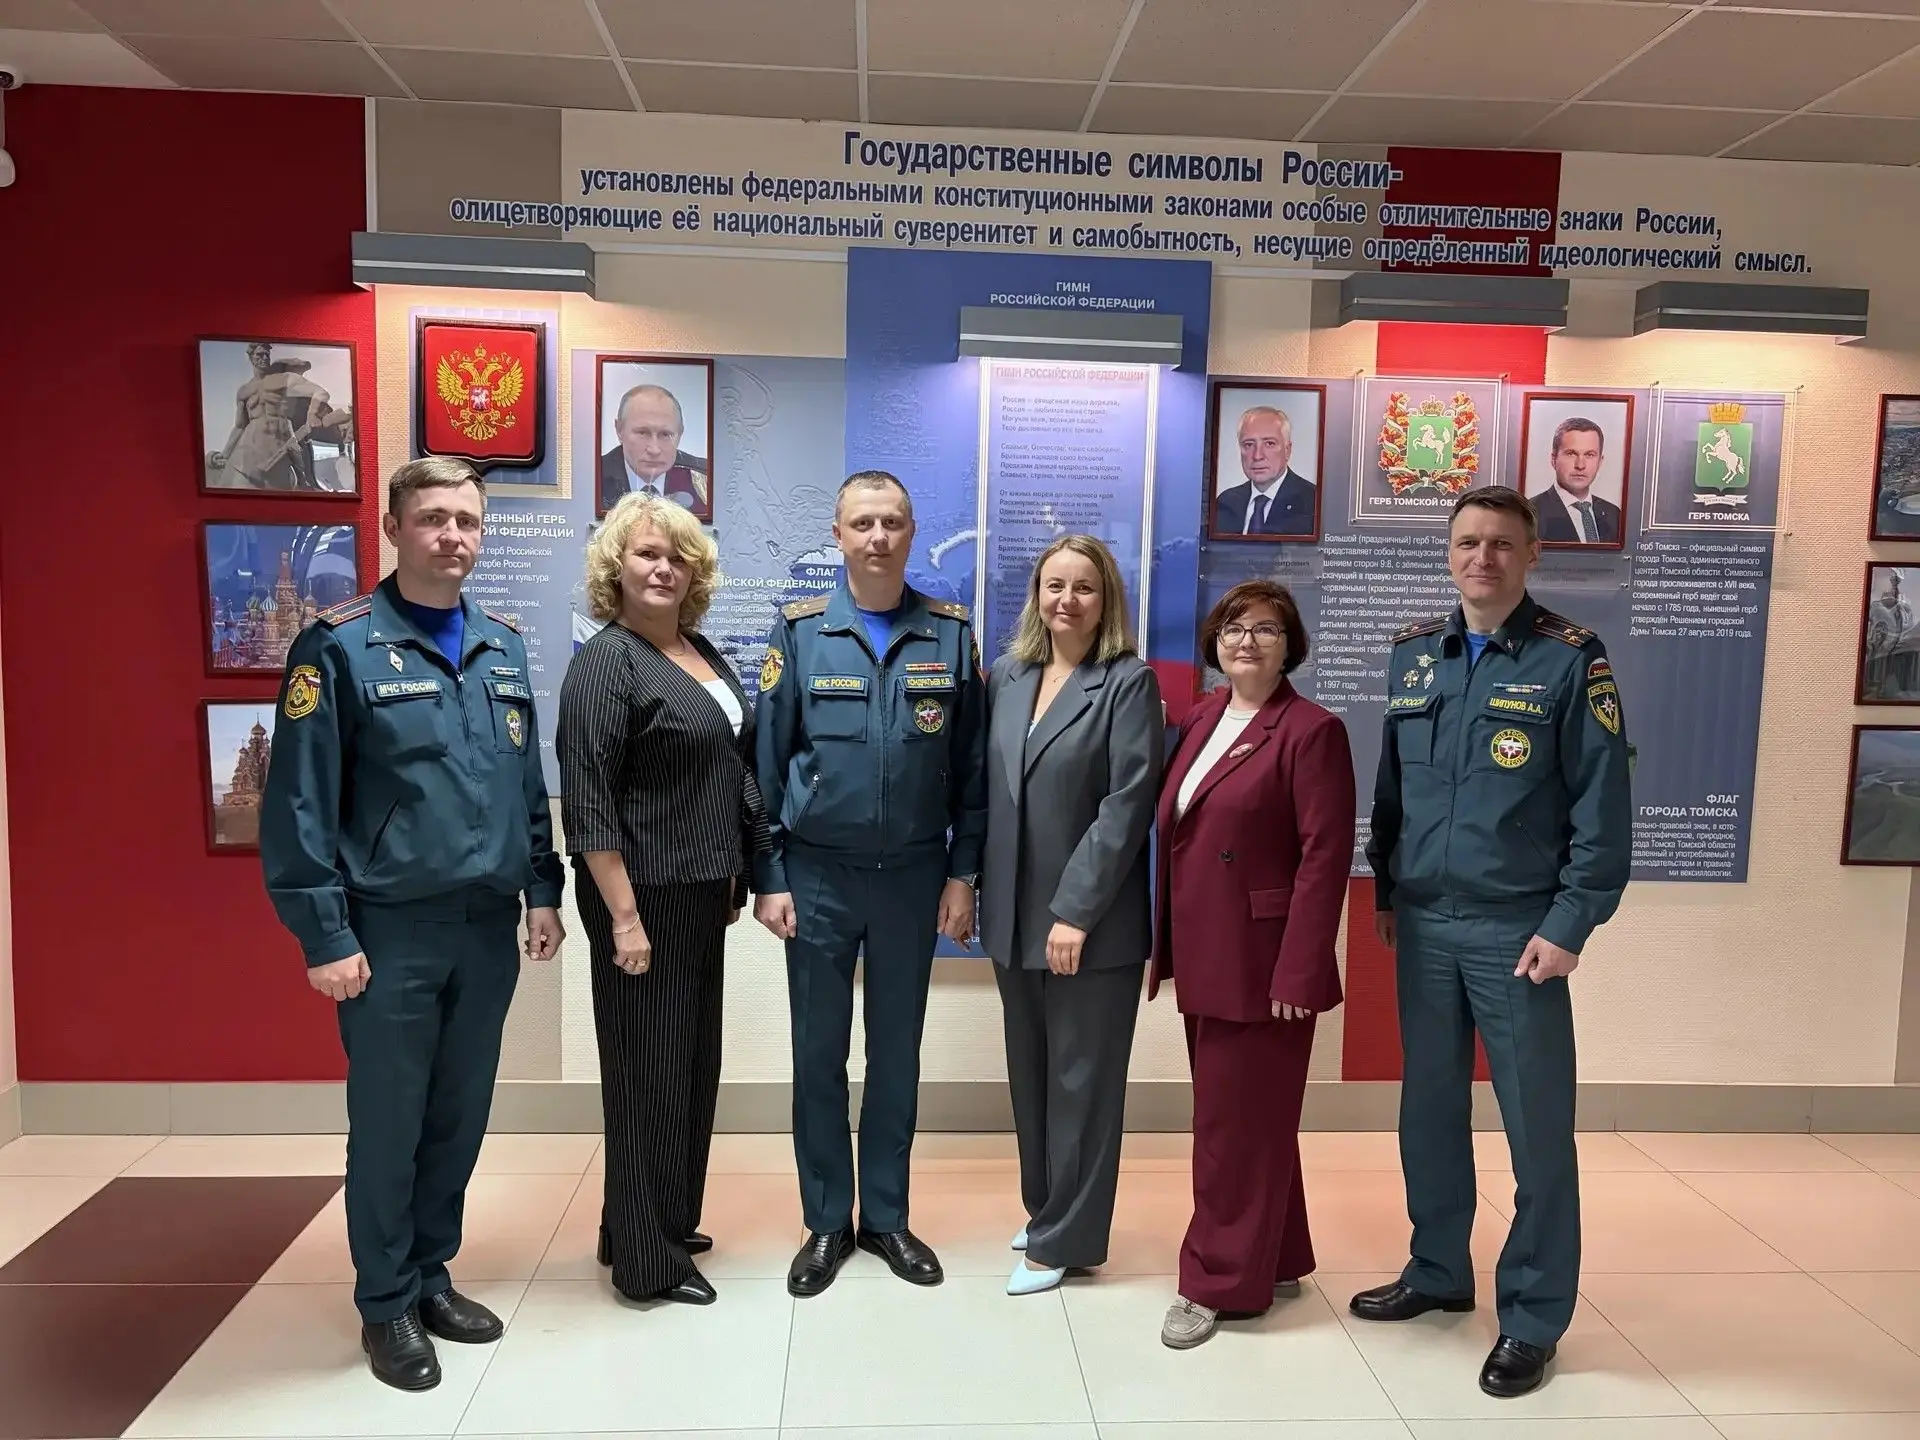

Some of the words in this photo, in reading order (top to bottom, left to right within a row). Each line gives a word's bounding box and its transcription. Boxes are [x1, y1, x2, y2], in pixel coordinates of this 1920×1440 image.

[843, 131, 1112, 177] Государственные
[1128, 152, 1263, 183] символы
[1282, 151, 1402, 189] России-
[580, 168, 734, 197] установлены
[741, 171, 923, 204] федеральными
[934, 185, 1153, 215] конституционными
[1164, 195, 1273, 220] законами
[1282, 196, 1367, 225] особые
[1378, 202, 1551, 232] отличительные
[1559, 209, 1623, 232] знаки
[1635, 207, 1722, 241] России,
[450, 198, 662, 232] олицетворяющие
[672, 204, 700, 231] её
[713, 209, 884, 239] национальный
[894, 217, 1038, 247] суверенитет
[1050, 225, 1063, 245] и
[1072, 221, 1242, 258] самобытность,
[1253, 232, 1352, 261] несущие
[1539, 243, 1721, 270] идеологический
[1734, 251, 1812, 274] смысл.
[1056, 281, 1091, 293] ГИМН
[990, 293, 1076, 307] РОССИЙСКОЙ
[1078, 297, 1155, 310] ФЕДЕРАЦИИ
[1024, 367, 1086, 380] РОССИЙСКОЙ
[1088, 370, 1144, 382] ФЕДЕРАЦИИ
[1369, 497, 1392, 506] ГЕРБ
[1394, 497, 1439, 507] ТОМСКОЙ
[537, 514, 566, 525] ГЕРБ
[1688, 512, 1711, 520] ГЕРБ
[1712, 512, 1750, 521] ТОМСКА
[500, 527, 574, 539] ФЕДЕРАЦИИ
[1324, 534, 1357, 543] Большой
[1358, 535, 1412, 545] (праздничный)
[1412, 536, 1430, 545] герб
[1431, 536, 1450, 545] Томс
[486, 546, 505, 556] герб
[506, 546, 552, 556] Российской
[1323, 548, 1372, 556] представляет
[1374, 547, 1395, 556] собой
[1397, 549, 1444, 558] французский
[1637, 542, 1654, 552] Герб
[1655, 542, 1680, 551] Томска
[1689, 544, 1738, 553] официальный
[1740, 545, 1766, 553] символ
[479, 560, 501, 569] гербе
[503, 560, 531, 569] России
[1636, 555, 1660, 564] города
[1661, 554, 1688, 564] Томска,
[1690, 557, 1760, 565] административного
[1353, 561, 1379, 569] сторон
[806, 567, 837, 577] ФЛАГ
[1322, 571, 1357, 580] скачущий
[1364, 573, 1391, 582] правую
[1392, 574, 1421, 582] сторону
[1635, 568, 1659, 576] центра
[1660, 567, 1691, 575] Томской
[1691, 567, 1722, 576] области.
[1724, 568, 1764, 577] Символика
[475, 573, 507, 582] история
[515, 574, 549, 583] культура
[766, 578, 837, 590] ФЕДЕРАЦИИ
[1634, 580, 1658, 588] города
[1659, 580, 1717, 588] прослеживается
[1321, 595, 1338, 605] Щит
[1339, 597, 1367, 605] увенчан
[1369, 596, 1400, 605] большой
[1402, 598, 1457, 607] императорской
[1632, 591, 1680, 600] современный
[1682, 591, 1699, 601] герб
[506, 600, 542, 609] стороны,
[1665, 603, 1681, 612] 1785
[1741, 605, 1758, 614] герб
[1358, 609, 1393, 617] золотыми
[1395, 609, 1431, 618] дубовыми
[1320, 621, 1347, 629] витыми
[1670, 615, 1706, 624] Решением
[1708, 617, 1744, 626] городской
[1319, 632, 1350, 641] области.
[1630, 626, 1650, 636] Думы
[1652, 627, 1677, 636] Томска
[1678, 627, 1687, 636] 27
[1688, 629, 1714, 638] августа
[1716, 628, 1733, 637] 2019
[1319, 645, 1366, 653] изображения
[1317, 668, 1367, 677] Современный
[1368, 669, 1386, 678] герб
[379, 683, 400, 695] МЧС
[401, 681, 438, 693] РОССИИ
[814, 678, 830, 688] МЧС
[831, 678, 862, 688] РОССИИ
[1323, 681, 1340, 689] 1997
[1315, 693, 1346, 701] Автором
[1489, 697, 1526, 711] ШИПУНОВ
[1527, 703, 1543, 714] А.А.
[1706, 794, 1739, 804] ФЛАГ
[1639, 806, 1687, 818] ГОРОДА
[1689, 807, 1738, 818] ТОМСКА
[1632, 841, 1650, 849] рода
[1707, 841, 1736, 849] области
